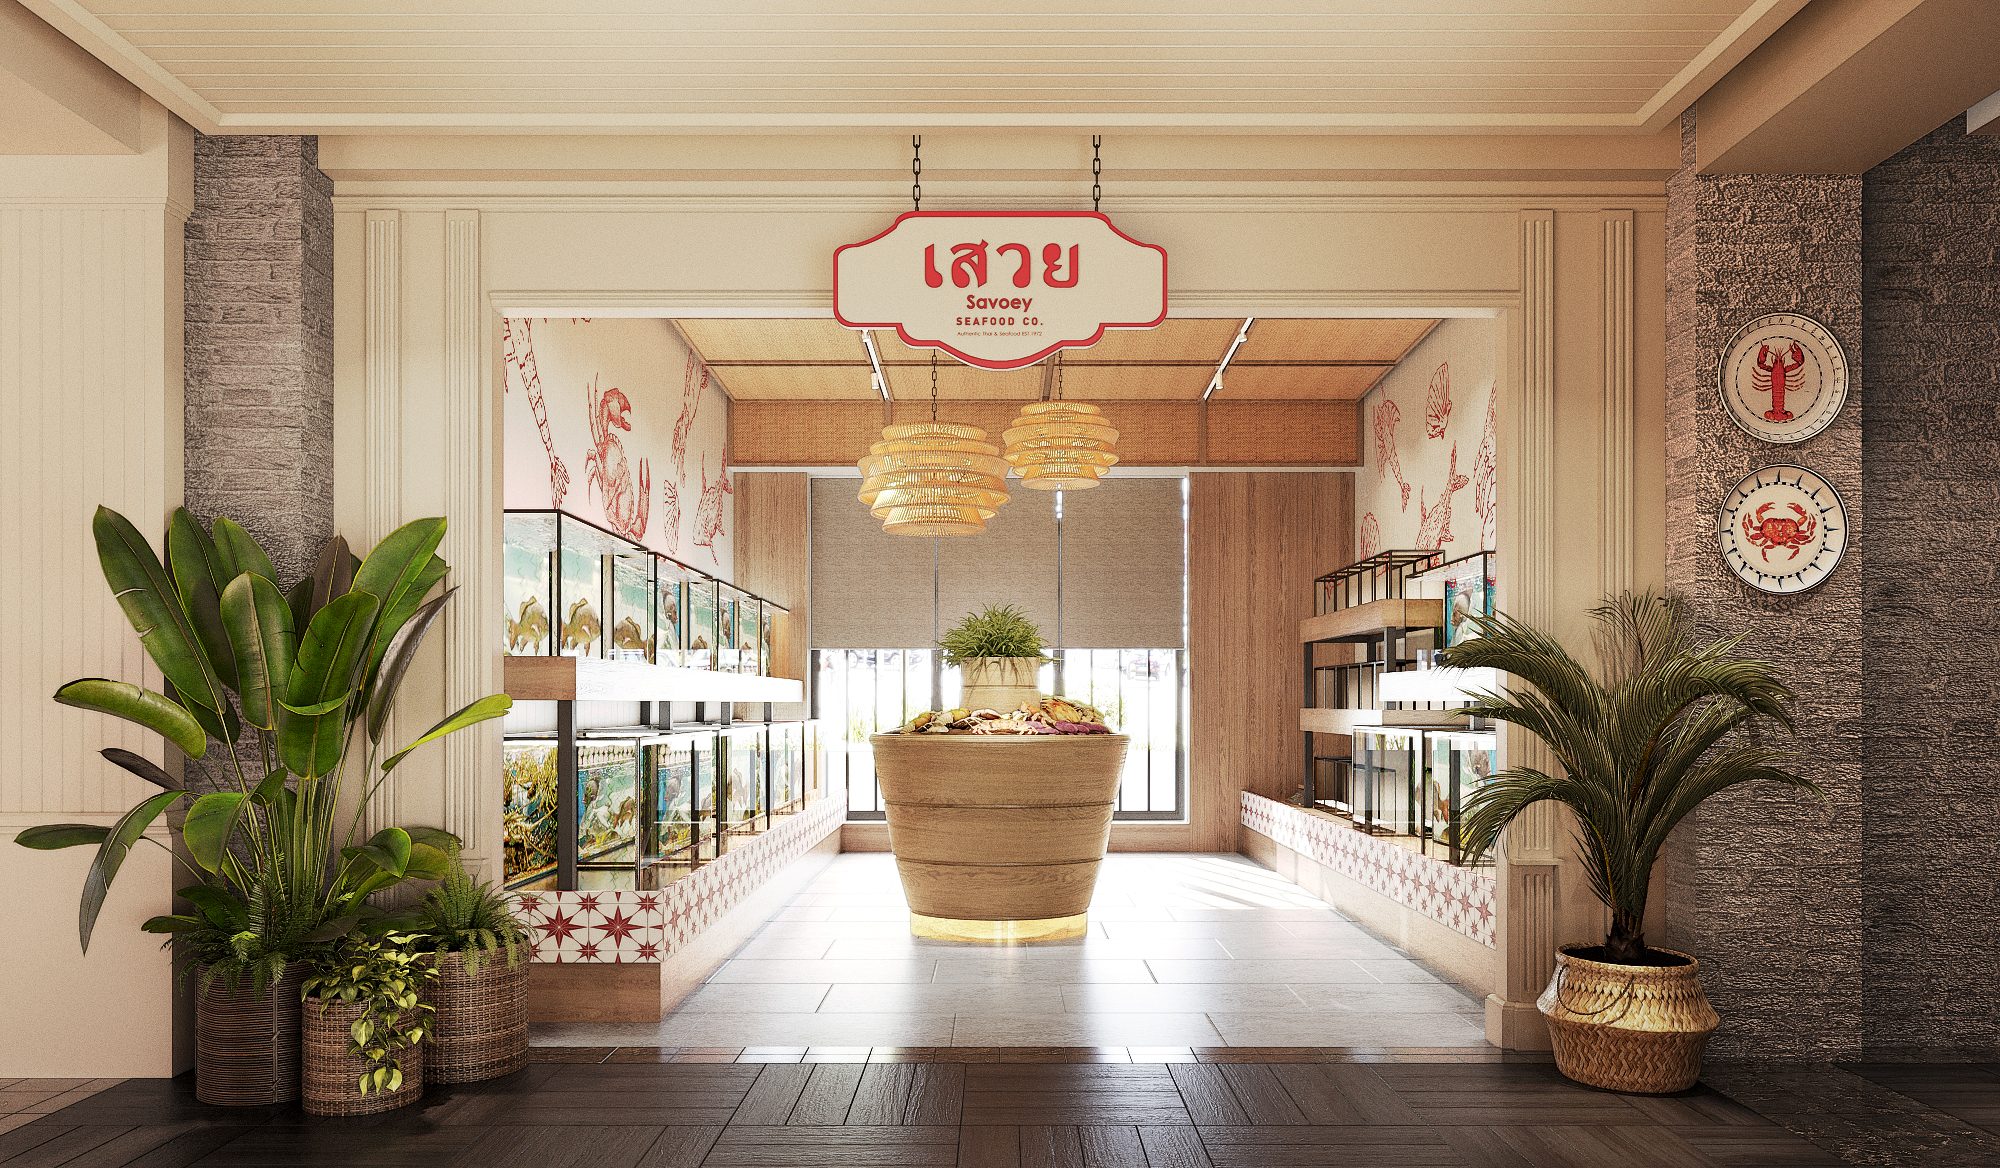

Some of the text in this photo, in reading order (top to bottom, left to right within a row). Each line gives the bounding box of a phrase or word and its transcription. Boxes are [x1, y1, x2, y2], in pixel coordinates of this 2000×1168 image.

[924, 239, 1079, 288] เสวย
[966, 294, 1033, 312] Savoey
[956, 317, 1044, 326] SEAFOOD CO.
